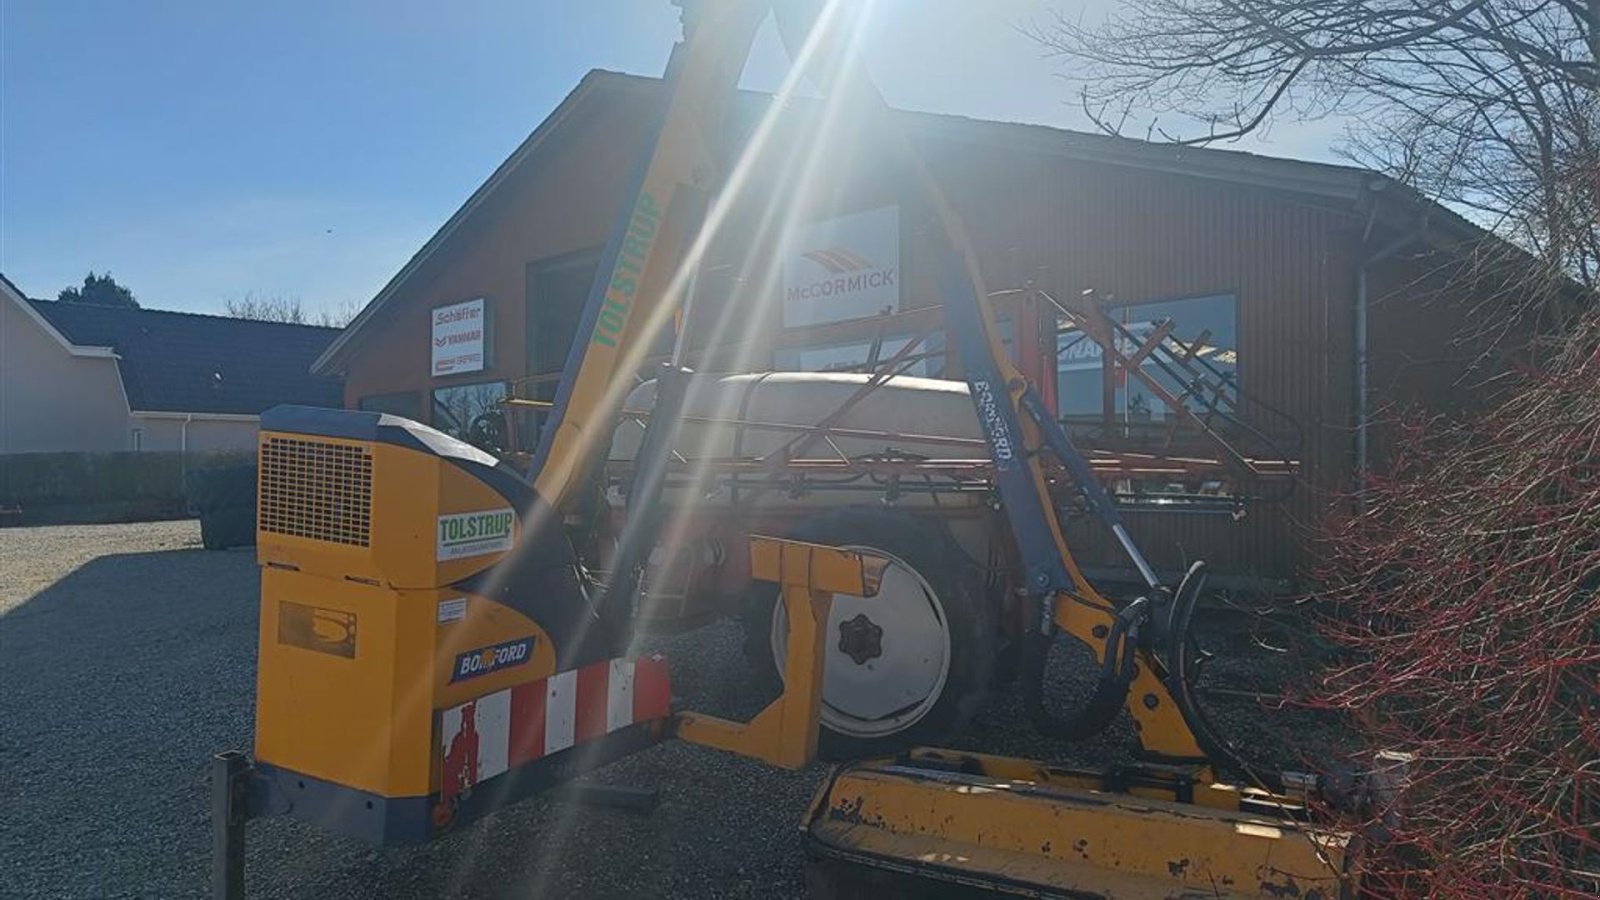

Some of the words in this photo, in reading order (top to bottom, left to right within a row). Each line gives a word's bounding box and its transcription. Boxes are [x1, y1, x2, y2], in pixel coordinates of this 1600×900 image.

[594, 192, 659, 347] TOLSTRUP
[786, 268, 895, 302] McCORMICK
[440, 511, 512, 541] TOLSTRUP
[460, 643, 527, 675] BOFORD
